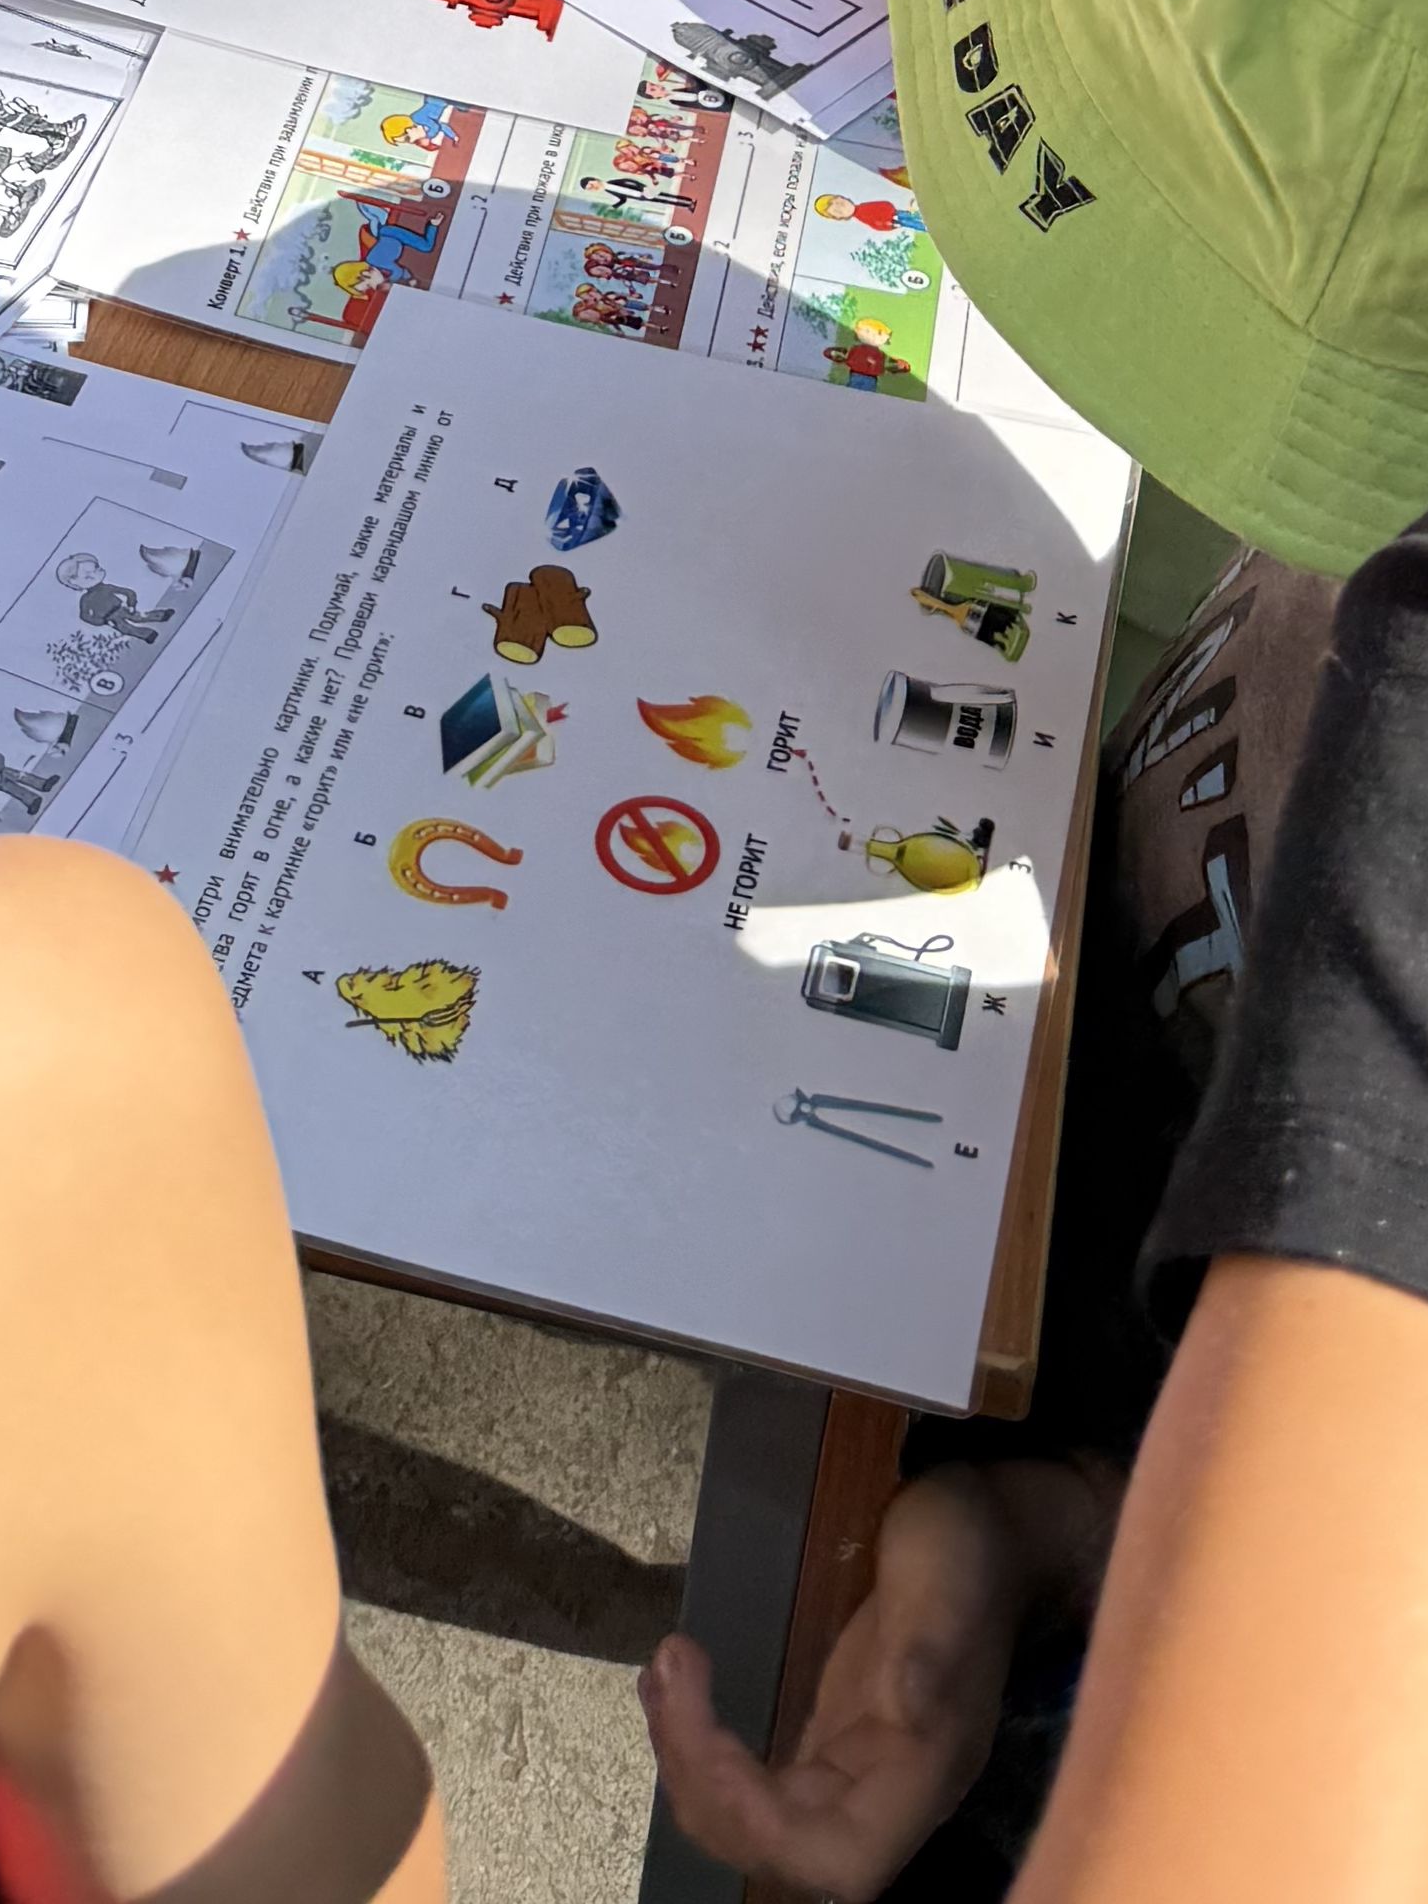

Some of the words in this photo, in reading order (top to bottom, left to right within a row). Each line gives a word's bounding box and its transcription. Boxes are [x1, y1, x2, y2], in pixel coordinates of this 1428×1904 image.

[953, 22, 1098, 233] DAY
[545, 150, 558, 158] в
[207, 254, 242, 310] Конверт
[229, 245, 247, 257] 1.
[243, 166, 278, 225] Действия
[269, 145, 286, 167] при
[279, 78, 314, 142] задымлении
[429, 185, 444, 193] Б
[533, 161, 557, 202] пожаре
[526, 206, 543, 227] при
[670, 232, 686, 240] Б
[504, 228, 534, 286] Действия
[907, 276, 924, 285] Б
[494, 477, 518, 493] Д
[451, 586, 470, 598] Г
[219, 747, 279, 860] внимательно
[274, 656, 320, 732] картинки.
[309, 573, 360, 642] Подумай,
[349, 515, 380, 558] какие
[374, 425, 417, 503] материалы
[412, 404, 427, 414] и
[1055, 613, 1078, 625] К
[228, 871, 261, 922] горят
[253, 850, 270, 862] в
[263, 797, 297, 840] огне,
[286, 774, 301, 786] а
[294, 715, 327, 764] какие
[320, 668, 346, 706] нет?
[334, 592, 379, 660] Проведи
[372, 490, 421, 583] карандашом
[414, 435, 444, 482] линию
[437, 410, 454, 427] от
[359, 632, 395, 690] горит»:
[96, 678, 115, 691] В
[346, 694, 369, 724] «не
[403, 703, 426, 720] В
[953, 706, 984, 749] ВОДА
[1033, 732, 1056, 747] И
[330, 728, 354, 760] или
[766, 710, 801, 774] ГОРИТ
[303, 765, 338, 832] «горит»
[354, 831, 377, 847] Б
[731, 833, 769, 892] ГОРИТ
[265, 836, 311, 919] картинке
[723, 892, 751, 932] НЕ
[258, 924, 276, 936] к
[231, 941, 268, 1016] едмета
[302, 969, 325, 985] А
[981, 993, 1007, 1015] Ж
[954, 1142, 979, 1159] Е
